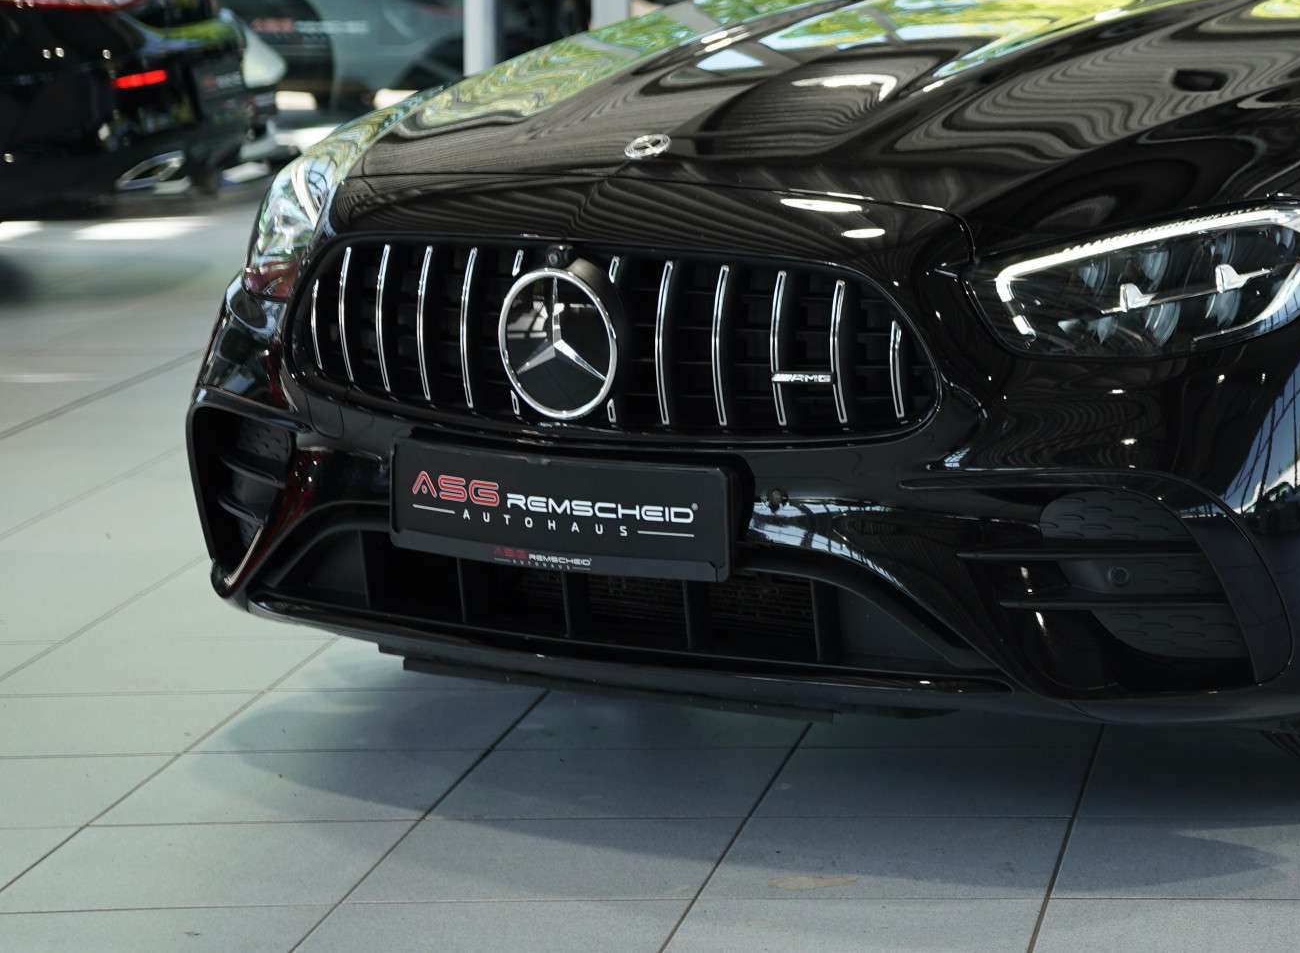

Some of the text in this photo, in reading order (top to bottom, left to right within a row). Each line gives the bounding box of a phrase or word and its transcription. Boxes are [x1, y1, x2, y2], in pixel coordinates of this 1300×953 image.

[788, 373, 831, 383] AMG
[411, 470, 695, 524] ASG REMSCHEID
[462, 508, 628, 537] AUTOHAUS
